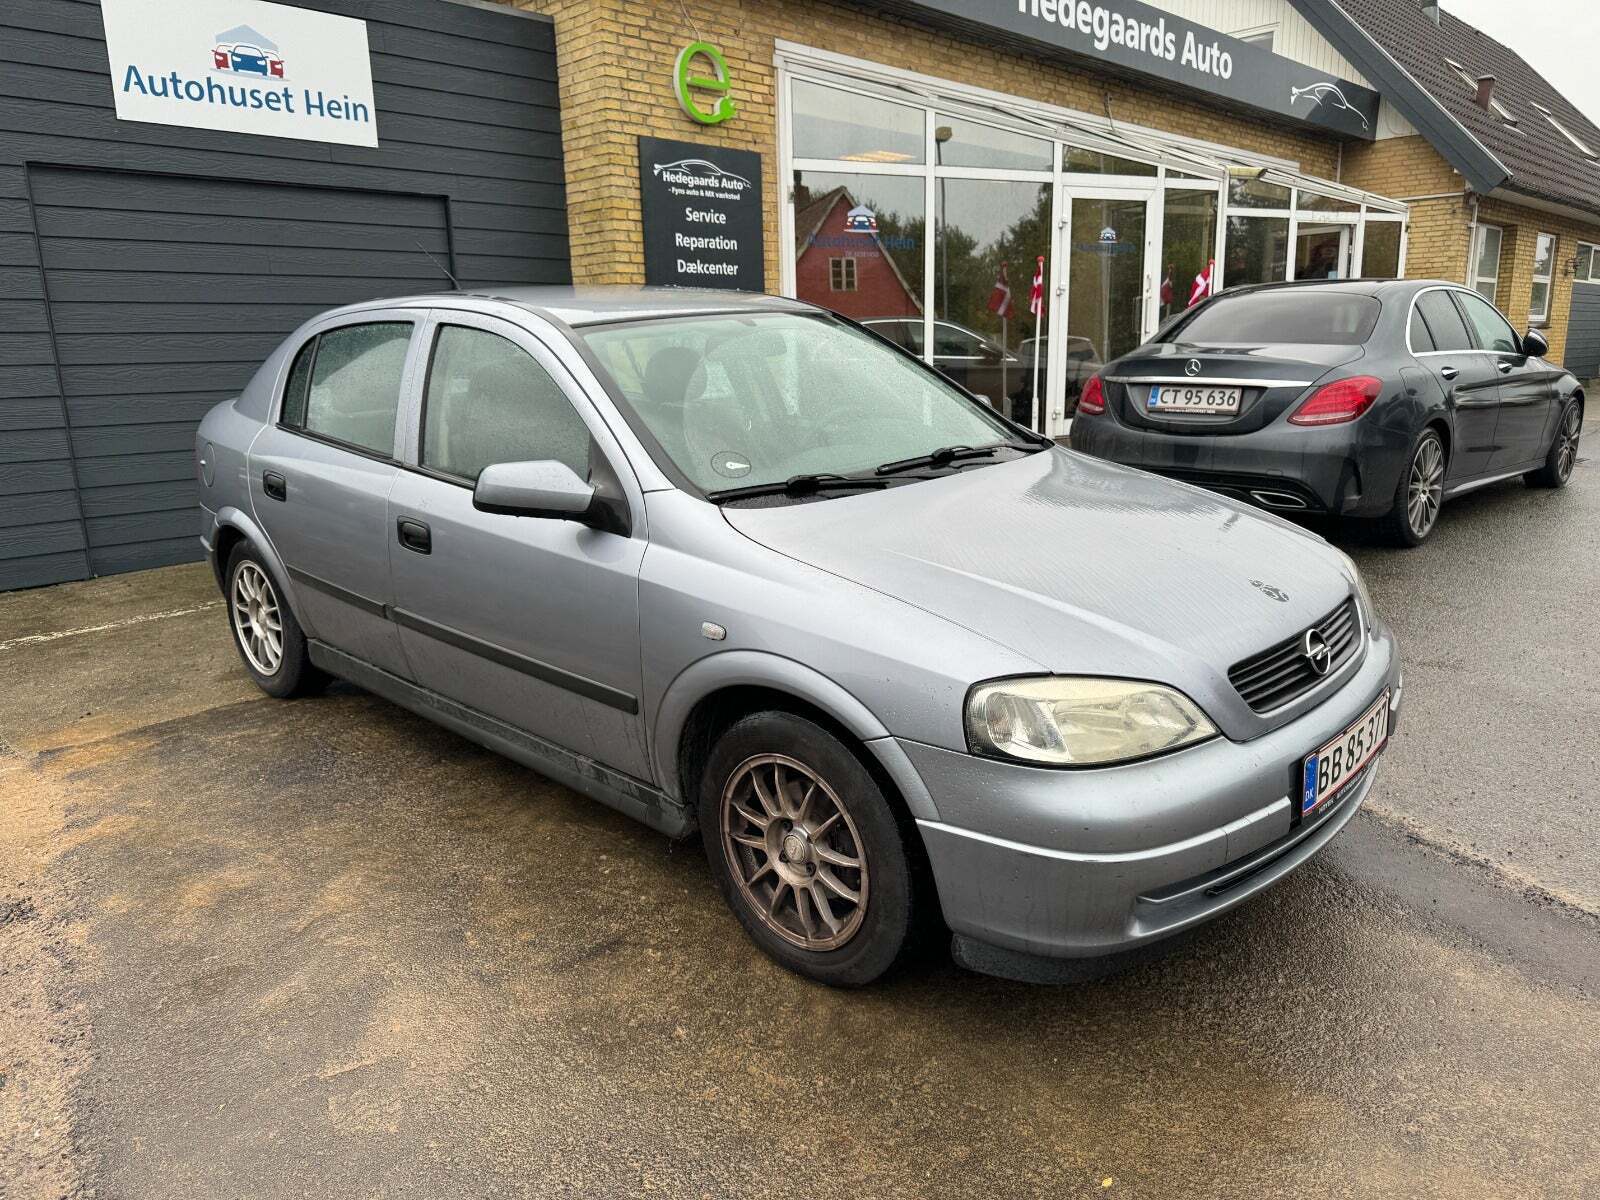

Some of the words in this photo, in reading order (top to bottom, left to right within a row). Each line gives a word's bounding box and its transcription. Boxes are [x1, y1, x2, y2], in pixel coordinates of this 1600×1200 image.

[1180, 31, 1233, 80] Auto
[123, 65, 296, 114] Autohuset
[304, 89, 369, 123] Hein
[662, 171, 719, 187] Hedegaards
[721, 178, 744, 190] Auto
[671, 186, 686, 196] Fyns
[685, 207, 727, 225] Service
[675, 232, 738, 252] Reparation
[676, 258, 739, 276] Dækcenter
[1160, 388, 1182, 404] CT
[1184, 389, 1204, 406] 95
[1206, 390, 1237, 407] 636
[1318, 745, 1343, 796] BB
[1345, 726, 1365, 772] 85
[1366, 699, 1387, 753] 377
[1304, 788, 1314, 802] DK
